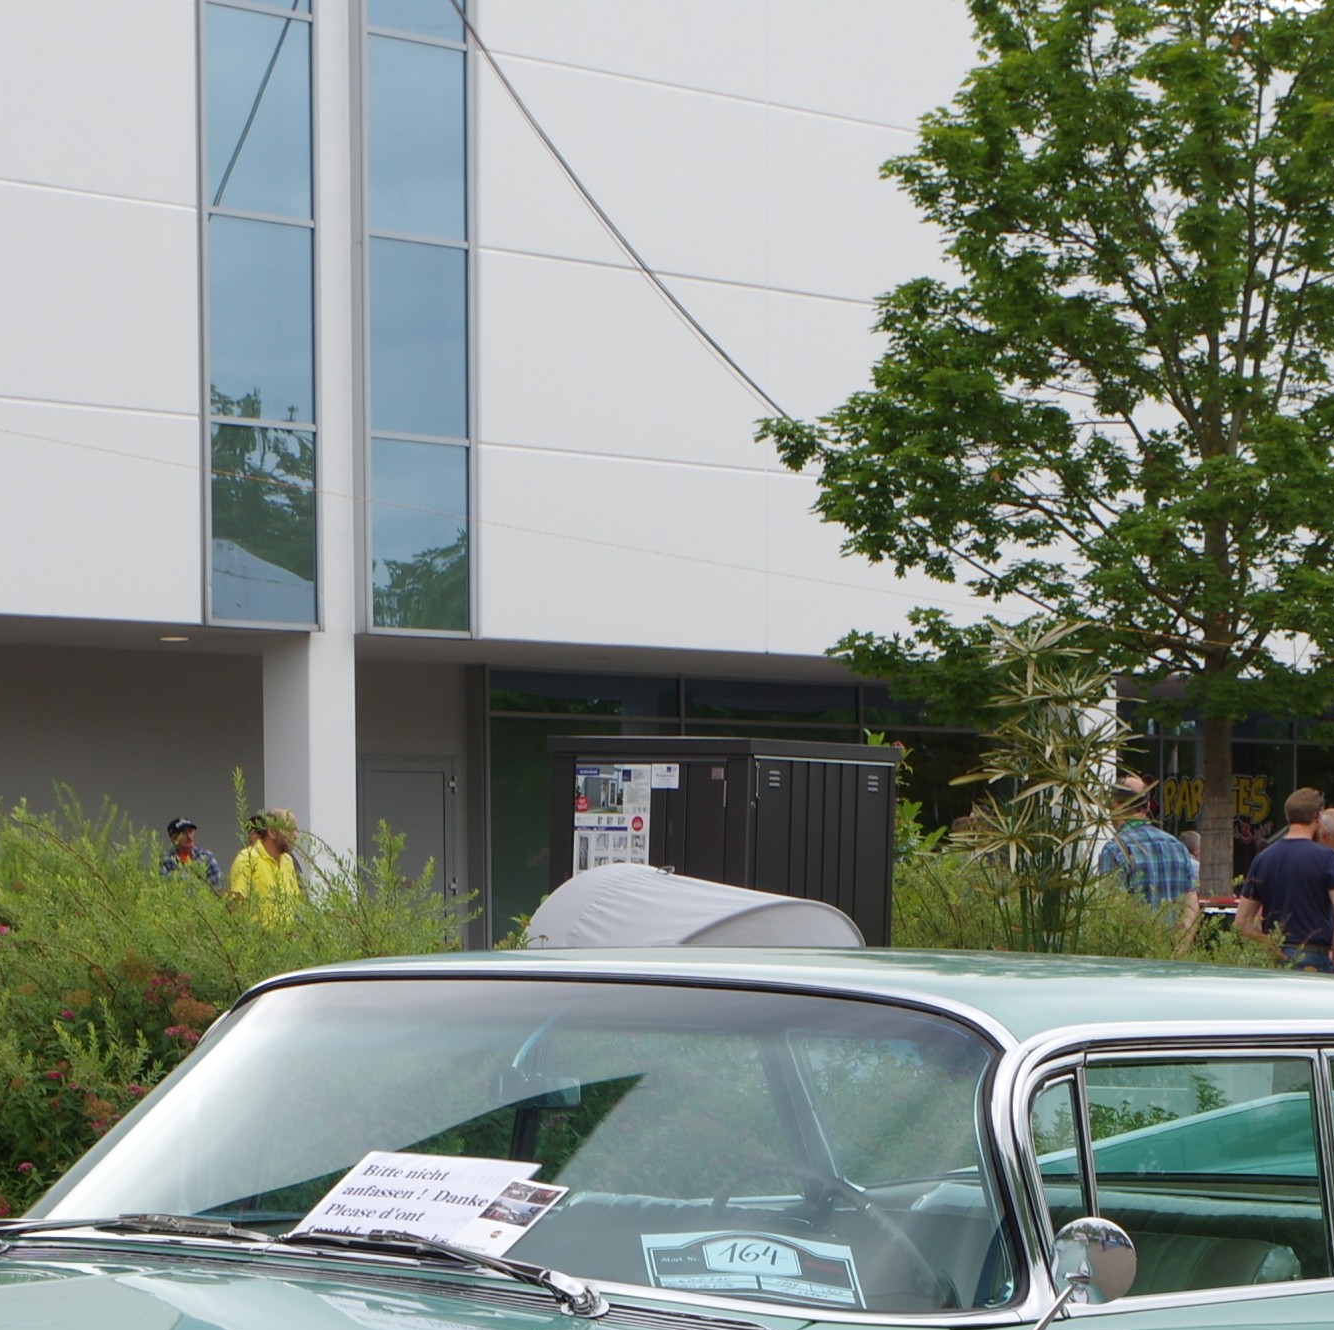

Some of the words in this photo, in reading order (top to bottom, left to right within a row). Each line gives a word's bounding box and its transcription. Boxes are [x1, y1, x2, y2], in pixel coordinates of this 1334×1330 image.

[362, 1165, 404, 1177] Bitte
[404, 1168, 450, 1181] nicht
[342, 1185, 414, 1200] anfassen
[432, 1189, 488, 1207] Danke
[323, 1203, 376, 1218] Please
[379, 1207, 426, 1222] d'ont
[718, 1242, 779, 1266] 164
